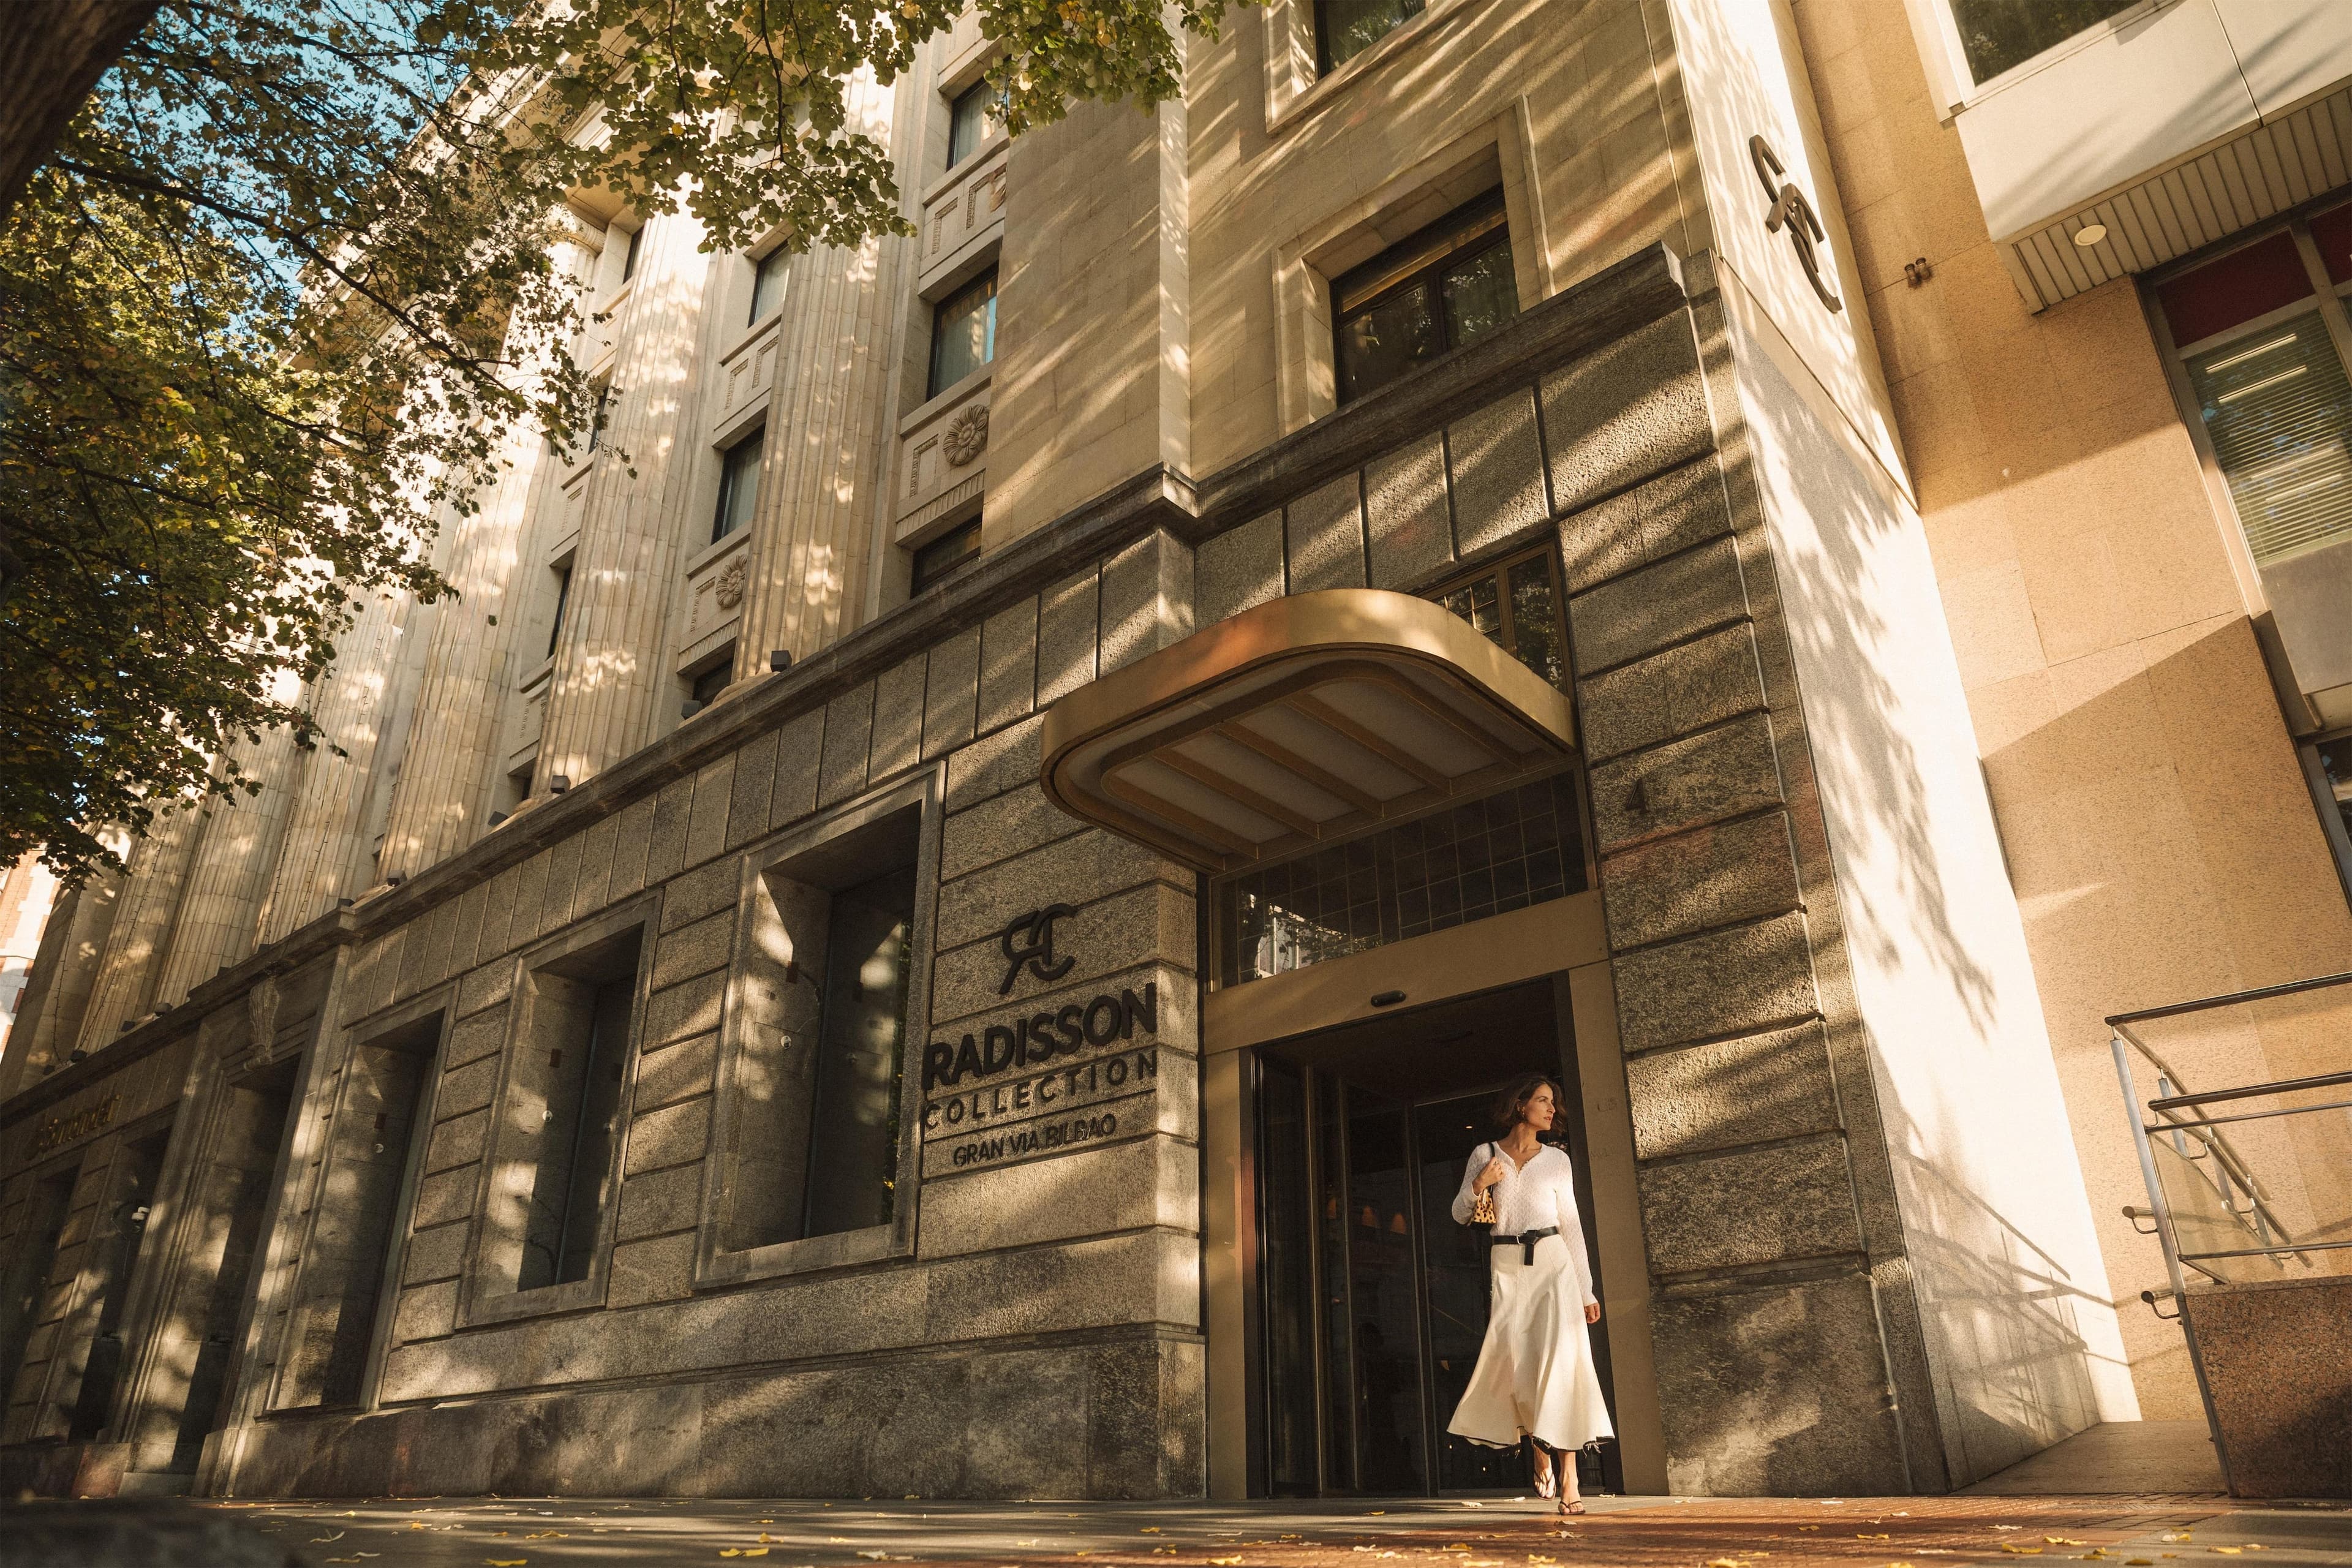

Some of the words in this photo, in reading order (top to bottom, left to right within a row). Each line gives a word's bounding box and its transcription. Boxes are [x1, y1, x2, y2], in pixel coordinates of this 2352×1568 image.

[922, 982, 1158, 1090] RADISSON
[924, 1050, 1158, 1130] COLLECTION
[953, 1137, 1004, 1166] GRAN
[1009, 1130, 1040, 1155] VIA
[1046, 1113, 1117, 1149] BILBAO
